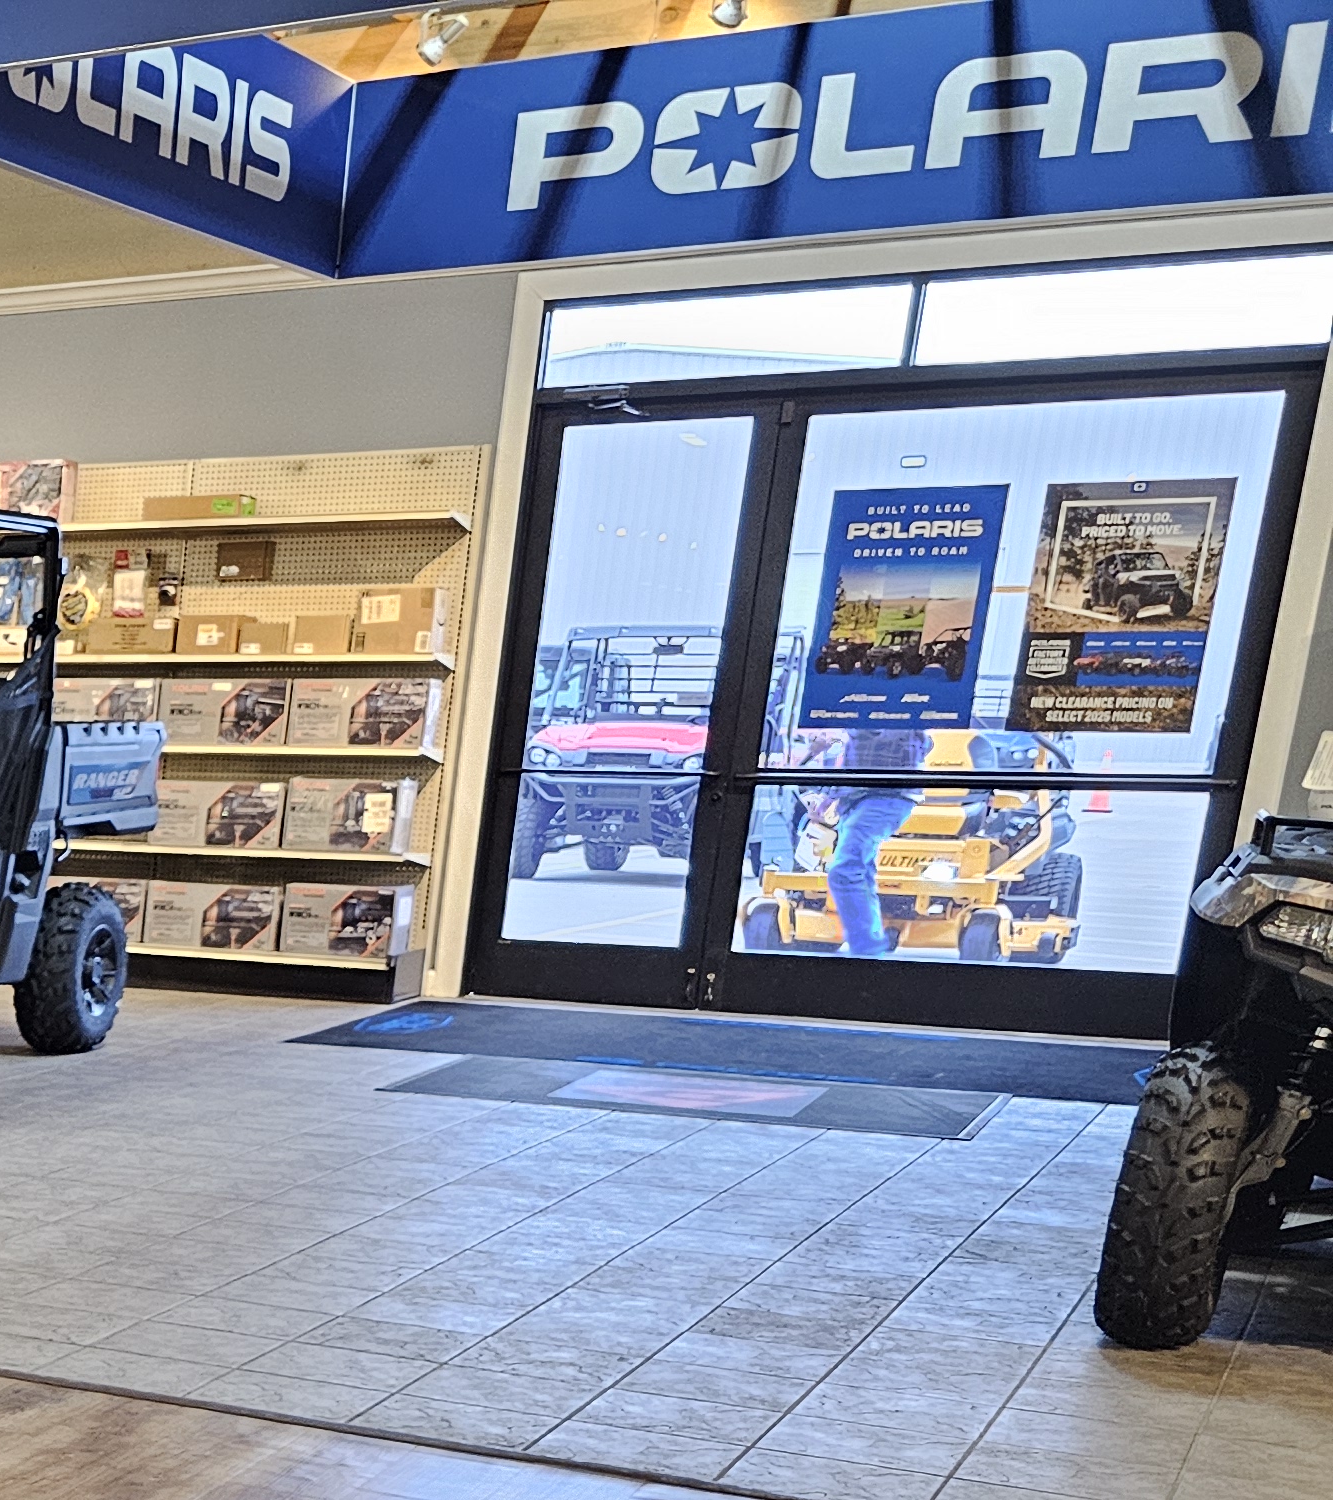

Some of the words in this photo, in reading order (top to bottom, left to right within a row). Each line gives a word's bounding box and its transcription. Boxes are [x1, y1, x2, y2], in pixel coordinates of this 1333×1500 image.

[508, 20, 1333, 210] POLARI
[8, 46, 293, 202] OLARIS
[867, 504, 907, 515] BUILT
[913, 504, 929, 514] TO
[935, 503, 971, 513] LEAD
[1096, 513, 1133, 524] BUILT
[1134, 512, 1151, 523] TO
[1152, 511, 1173, 523] GO.
[846, 519, 984, 540] POLARIS
[1081, 525, 1126, 538] PRICED
[1128, 525, 1145, 537] TO
[853, 548, 903, 558] DRIVEN
[909, 547, 925, 556] TO
[1030, 696, 1054, 708] NEW
[1055, 696, 1114, 709] CLEARANCE
[1115, 696, 1157, 708] PRICING
[1157, 696, 1174, 708] ON
[1045, 710, 1084, 722] SELECT
[1085, 711, 1111, 723] 2025
[1112, 711, 1153, 723] MODELS
[74, 769, 139, 791] RANGER
